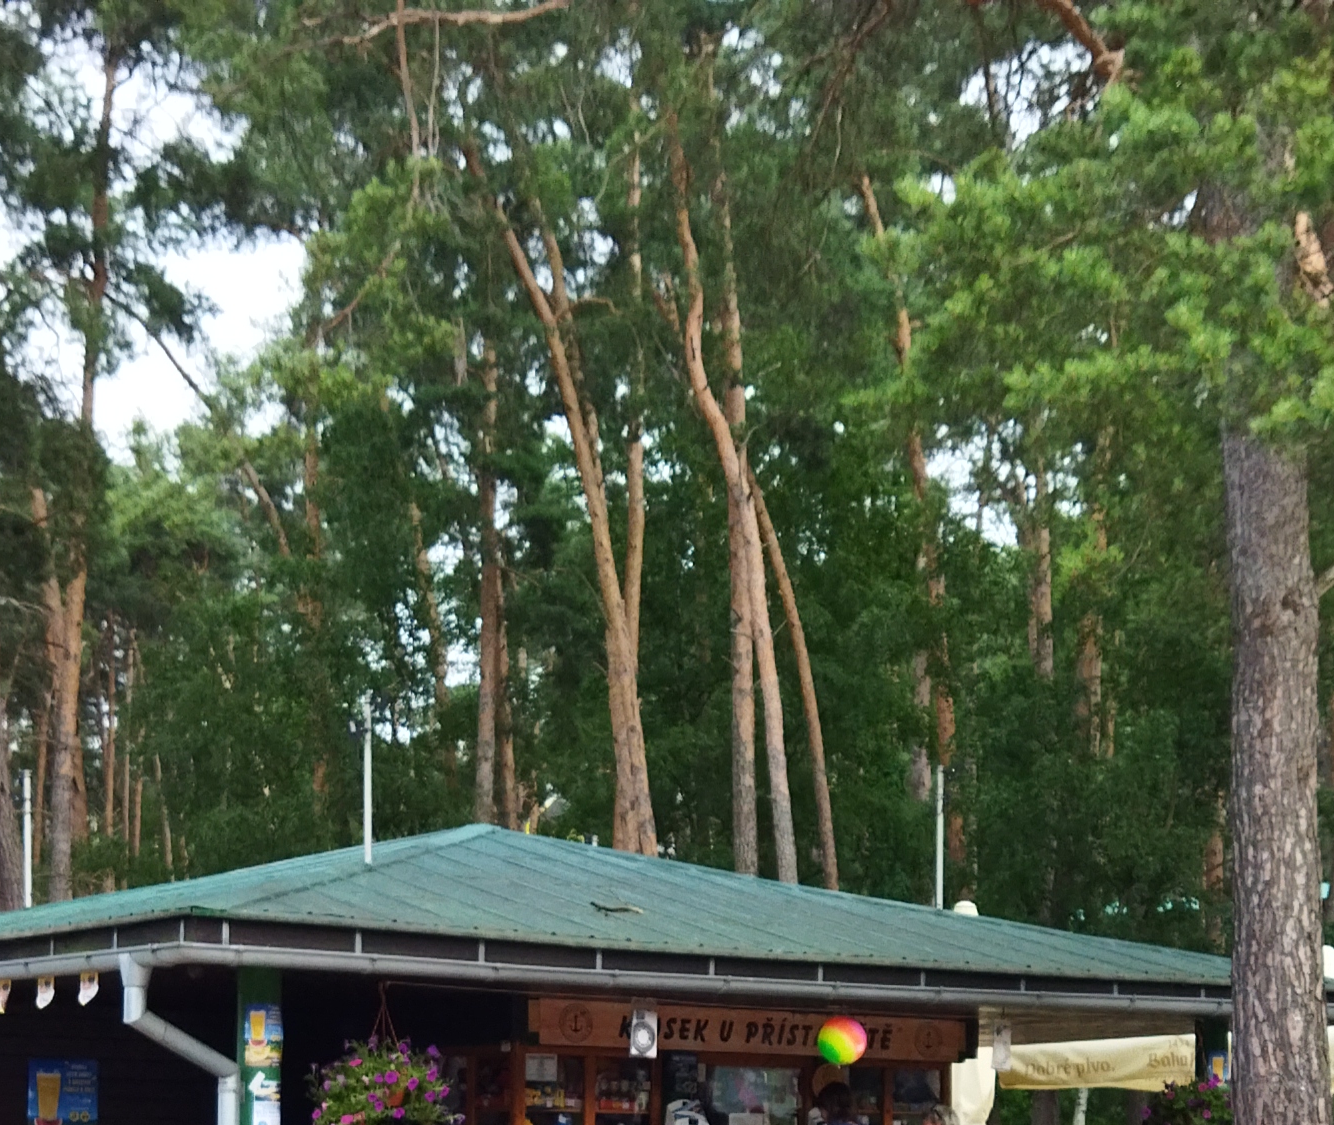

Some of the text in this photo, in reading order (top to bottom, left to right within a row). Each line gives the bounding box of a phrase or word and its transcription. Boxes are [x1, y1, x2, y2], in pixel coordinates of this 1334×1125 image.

[619, 1014, 894, 1050] KSEK U PŘÍSTTĚ
